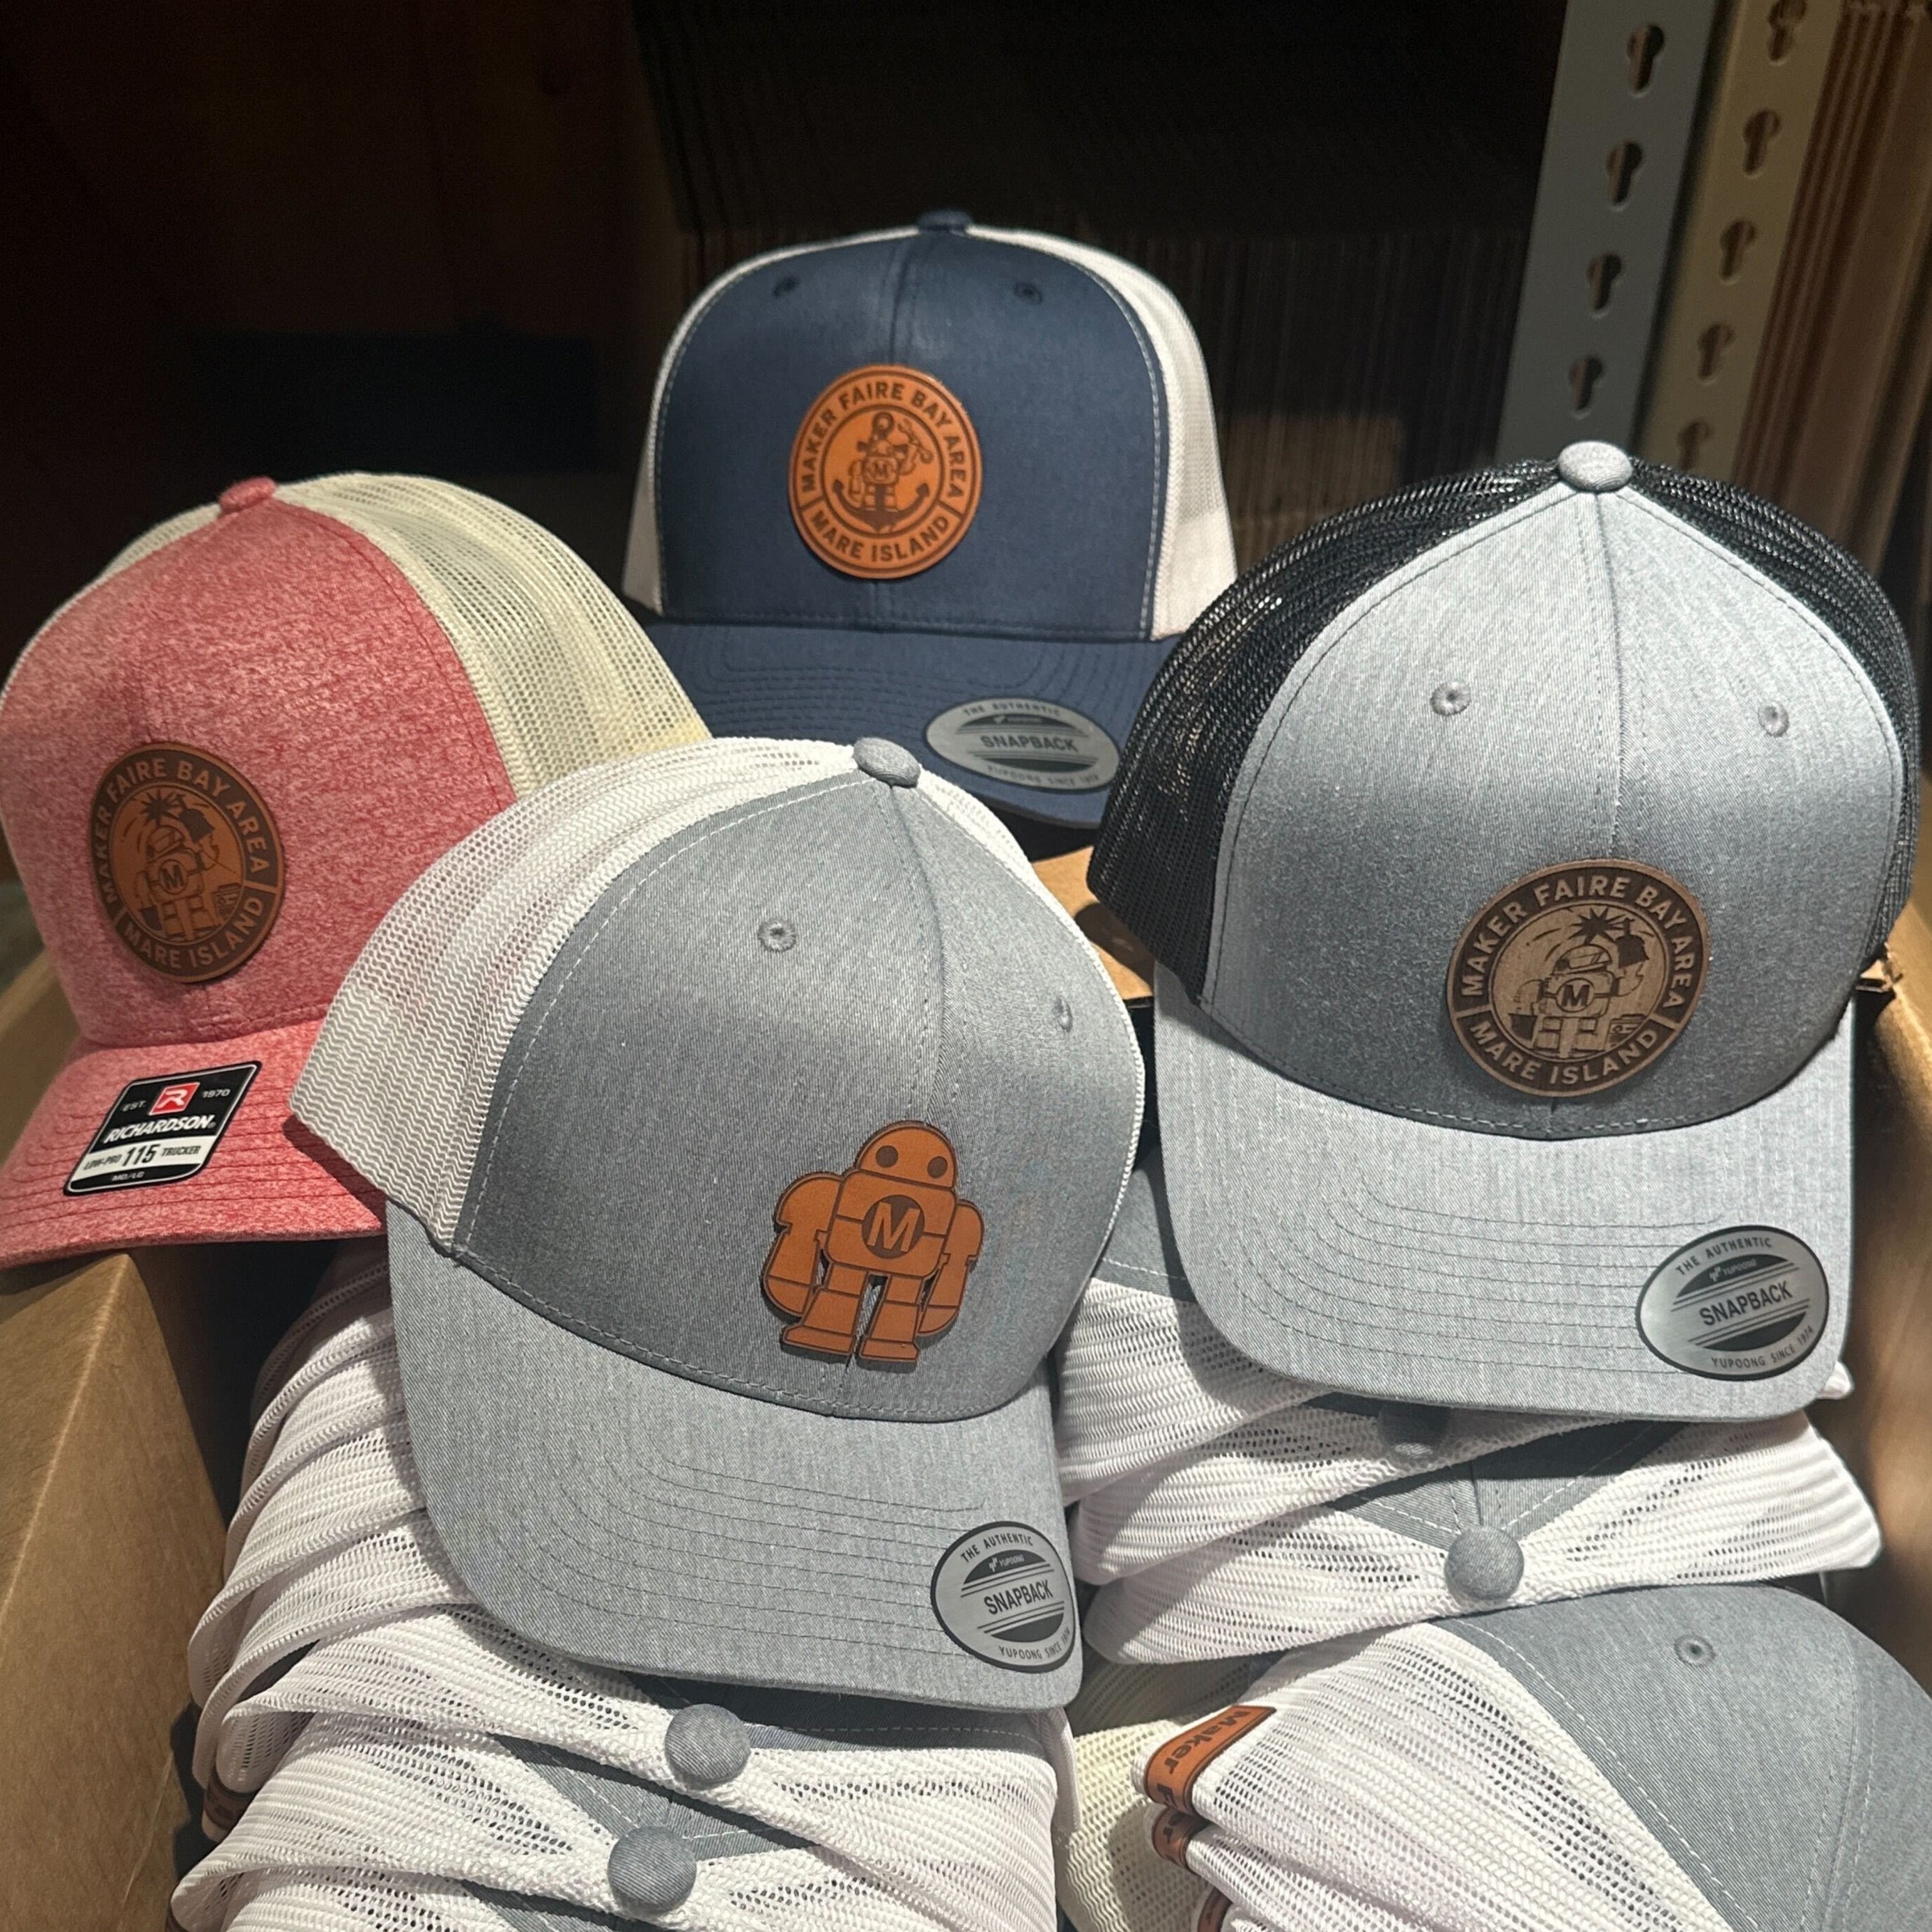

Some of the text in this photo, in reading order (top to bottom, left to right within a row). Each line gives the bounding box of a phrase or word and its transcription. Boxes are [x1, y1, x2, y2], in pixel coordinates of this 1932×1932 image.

[801, 382, 967, 498] MAKER FAIRE BAY AREA
[811, 510, 949, 562] MARE ISLAND
[980, 734, 1079, 752] SNAPBACK
[107, 757, 167, 803] FAIRE
[177, 761, 231, 797] BAY
[226, 802, 270, 873] AREA
[163, 864, 185, 888] M
[123, 897, 263, 969] MARE ISLAND
[1461, 875, 1696, 1010] MAKER FAIRE BAY AREA
[1561, 983, 1589, 1008] M
[1469, 1019, 1658, 1085] MARE ISLAND
[202, 1088, 231, 1099] 1970
[103, 1115, 215, 1144] RICHARDSON
[83, 1144, 202, 1171] LOW-PRO 115 TRUCKER
[867, 1201, 921, 1253] M
[1675, 1237, 1772, 1276] THE AUTHENTIC
[1699, 1280, 1793, 1327] SNAPBACK
[1711, 1357, 1765, 1369] YUPOONG
[1770, 1343, 1795, 1363] SINCE
[960, 1533, 1034, 1563] THE AUTHENTIC
[983, 1579, 1054, 1616] SNAPBACK
[998, 1641, 1062, 1660] YUPOONG SINCE
[1164, 1709, 1251, 1775] Maker
